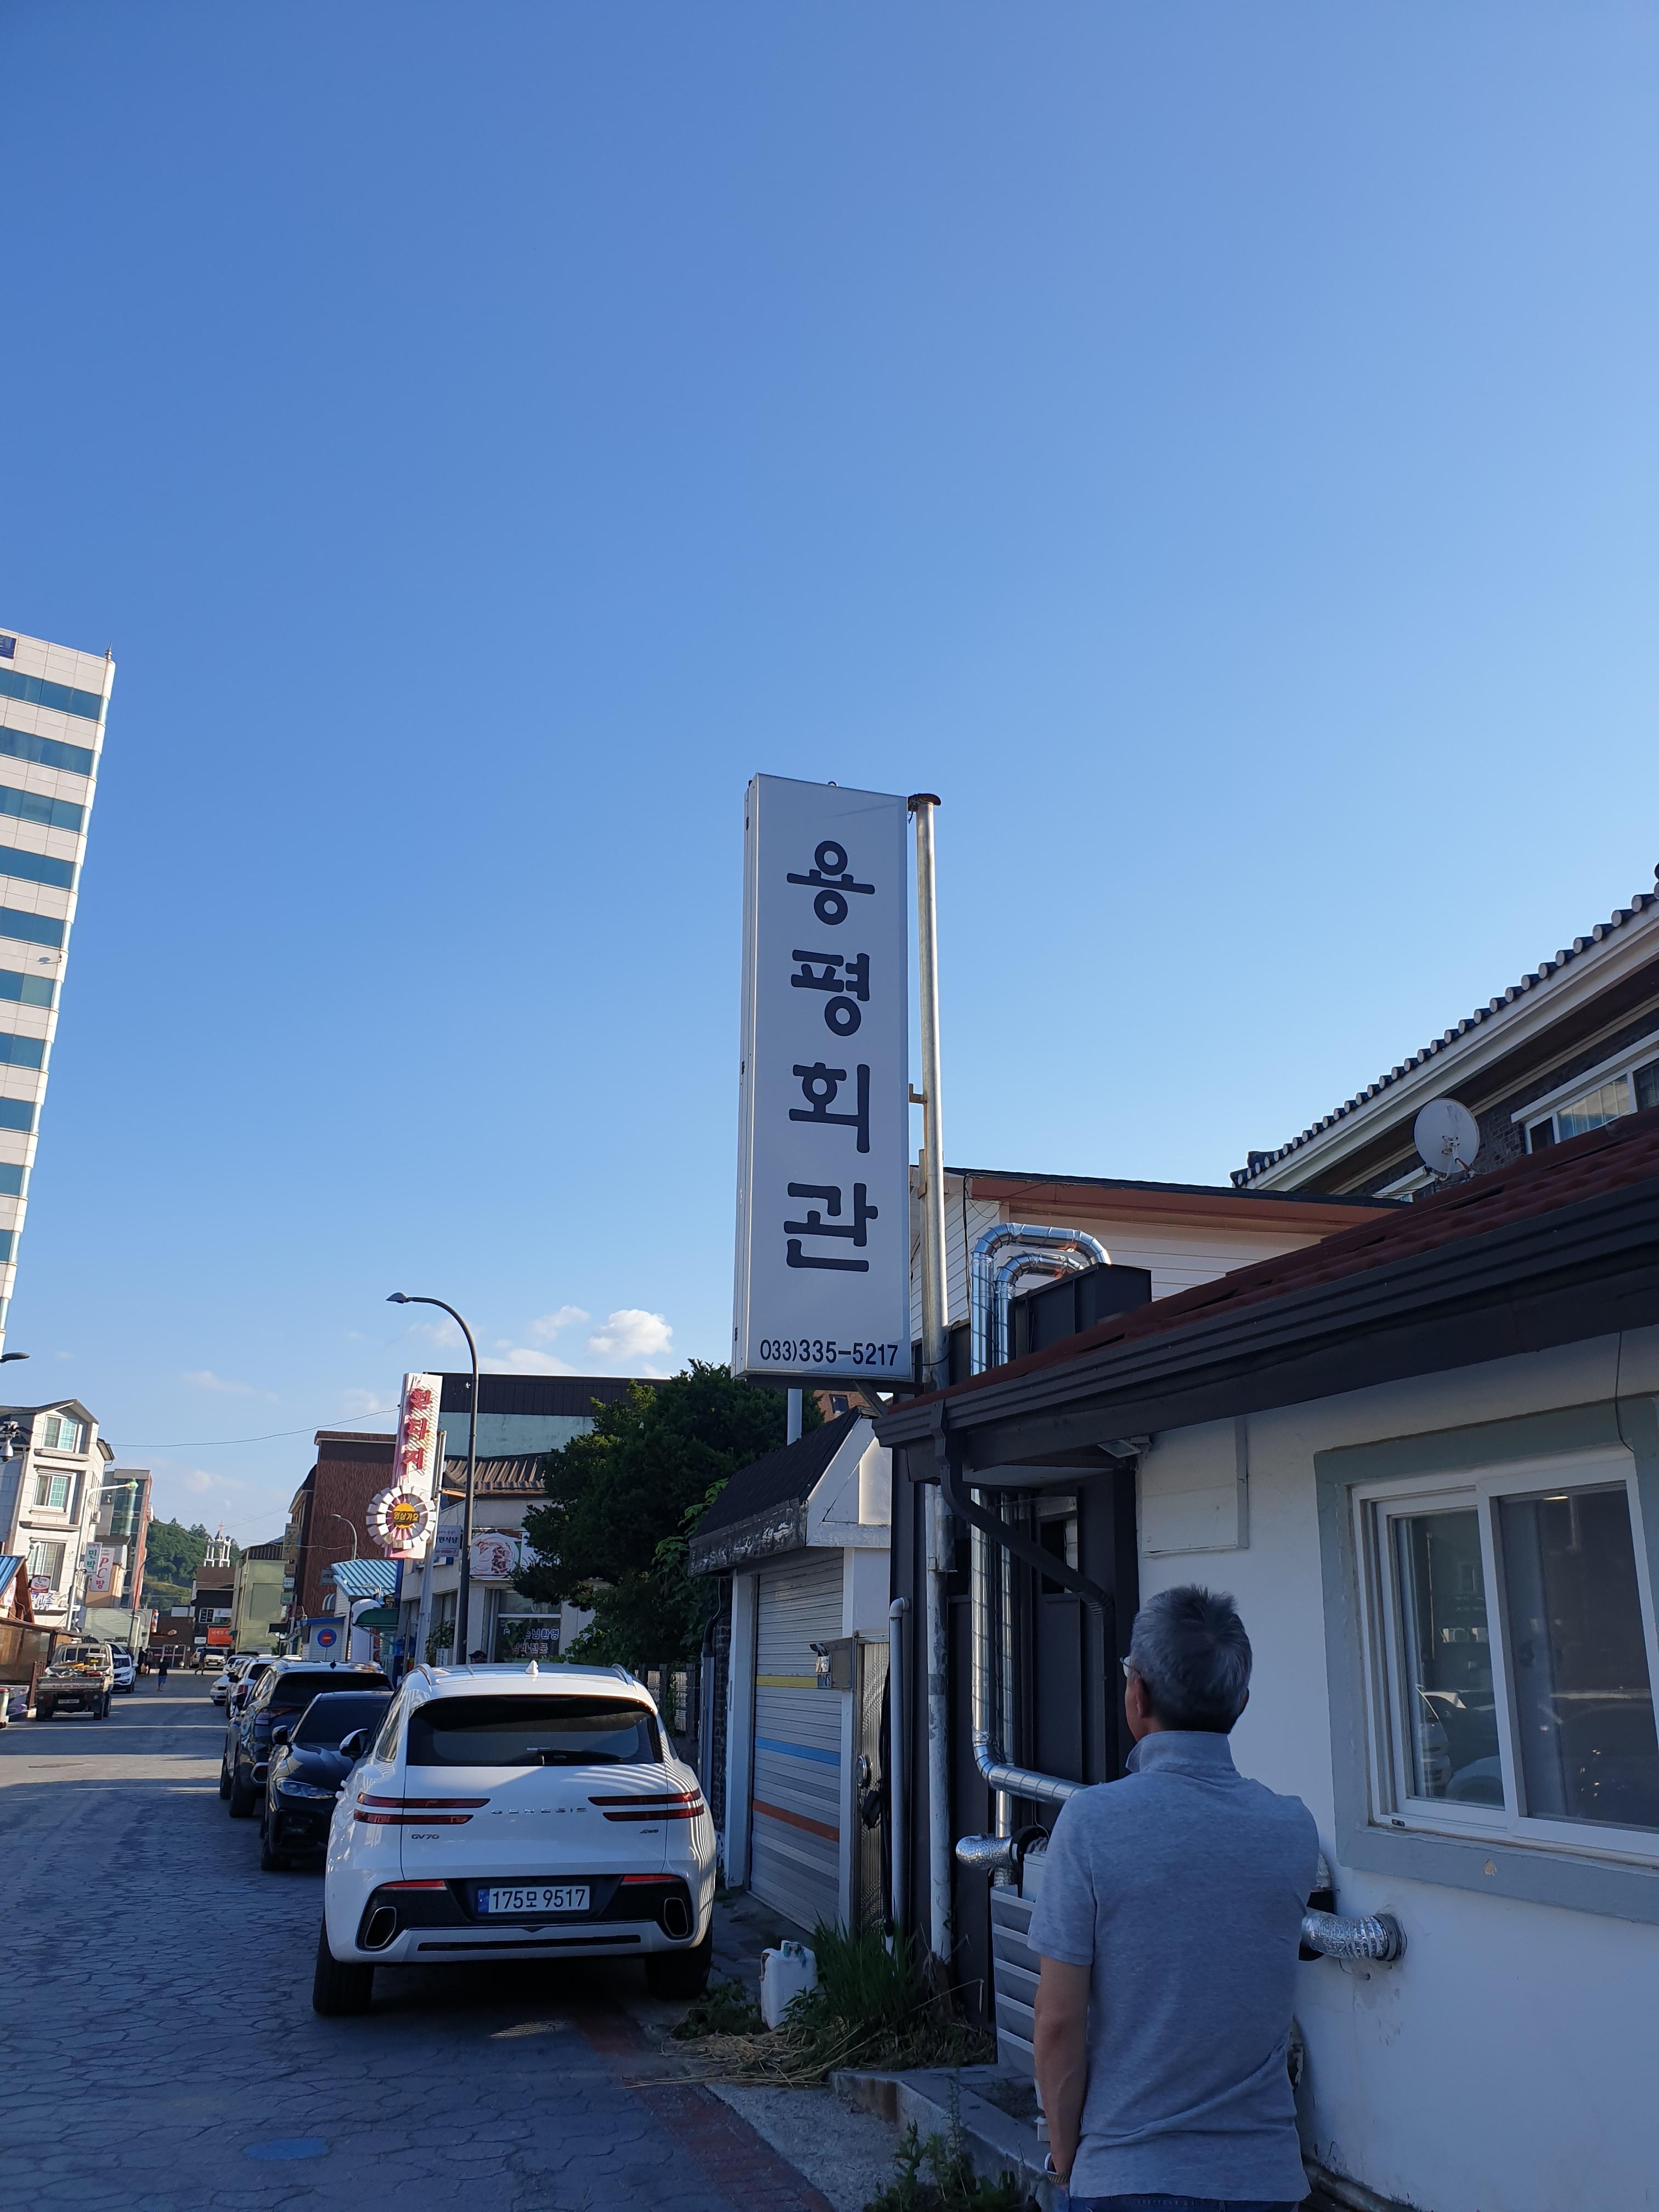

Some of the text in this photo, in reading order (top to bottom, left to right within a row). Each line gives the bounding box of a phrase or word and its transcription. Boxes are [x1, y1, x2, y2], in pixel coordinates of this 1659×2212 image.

[783, 840, 878, 1273] 용평회관
[760, 1339, 899, 1366] 033)335-5217
[87, 1549, 97, 1570] 민박
[492, 1889, 586, 1910] 175모 9517
